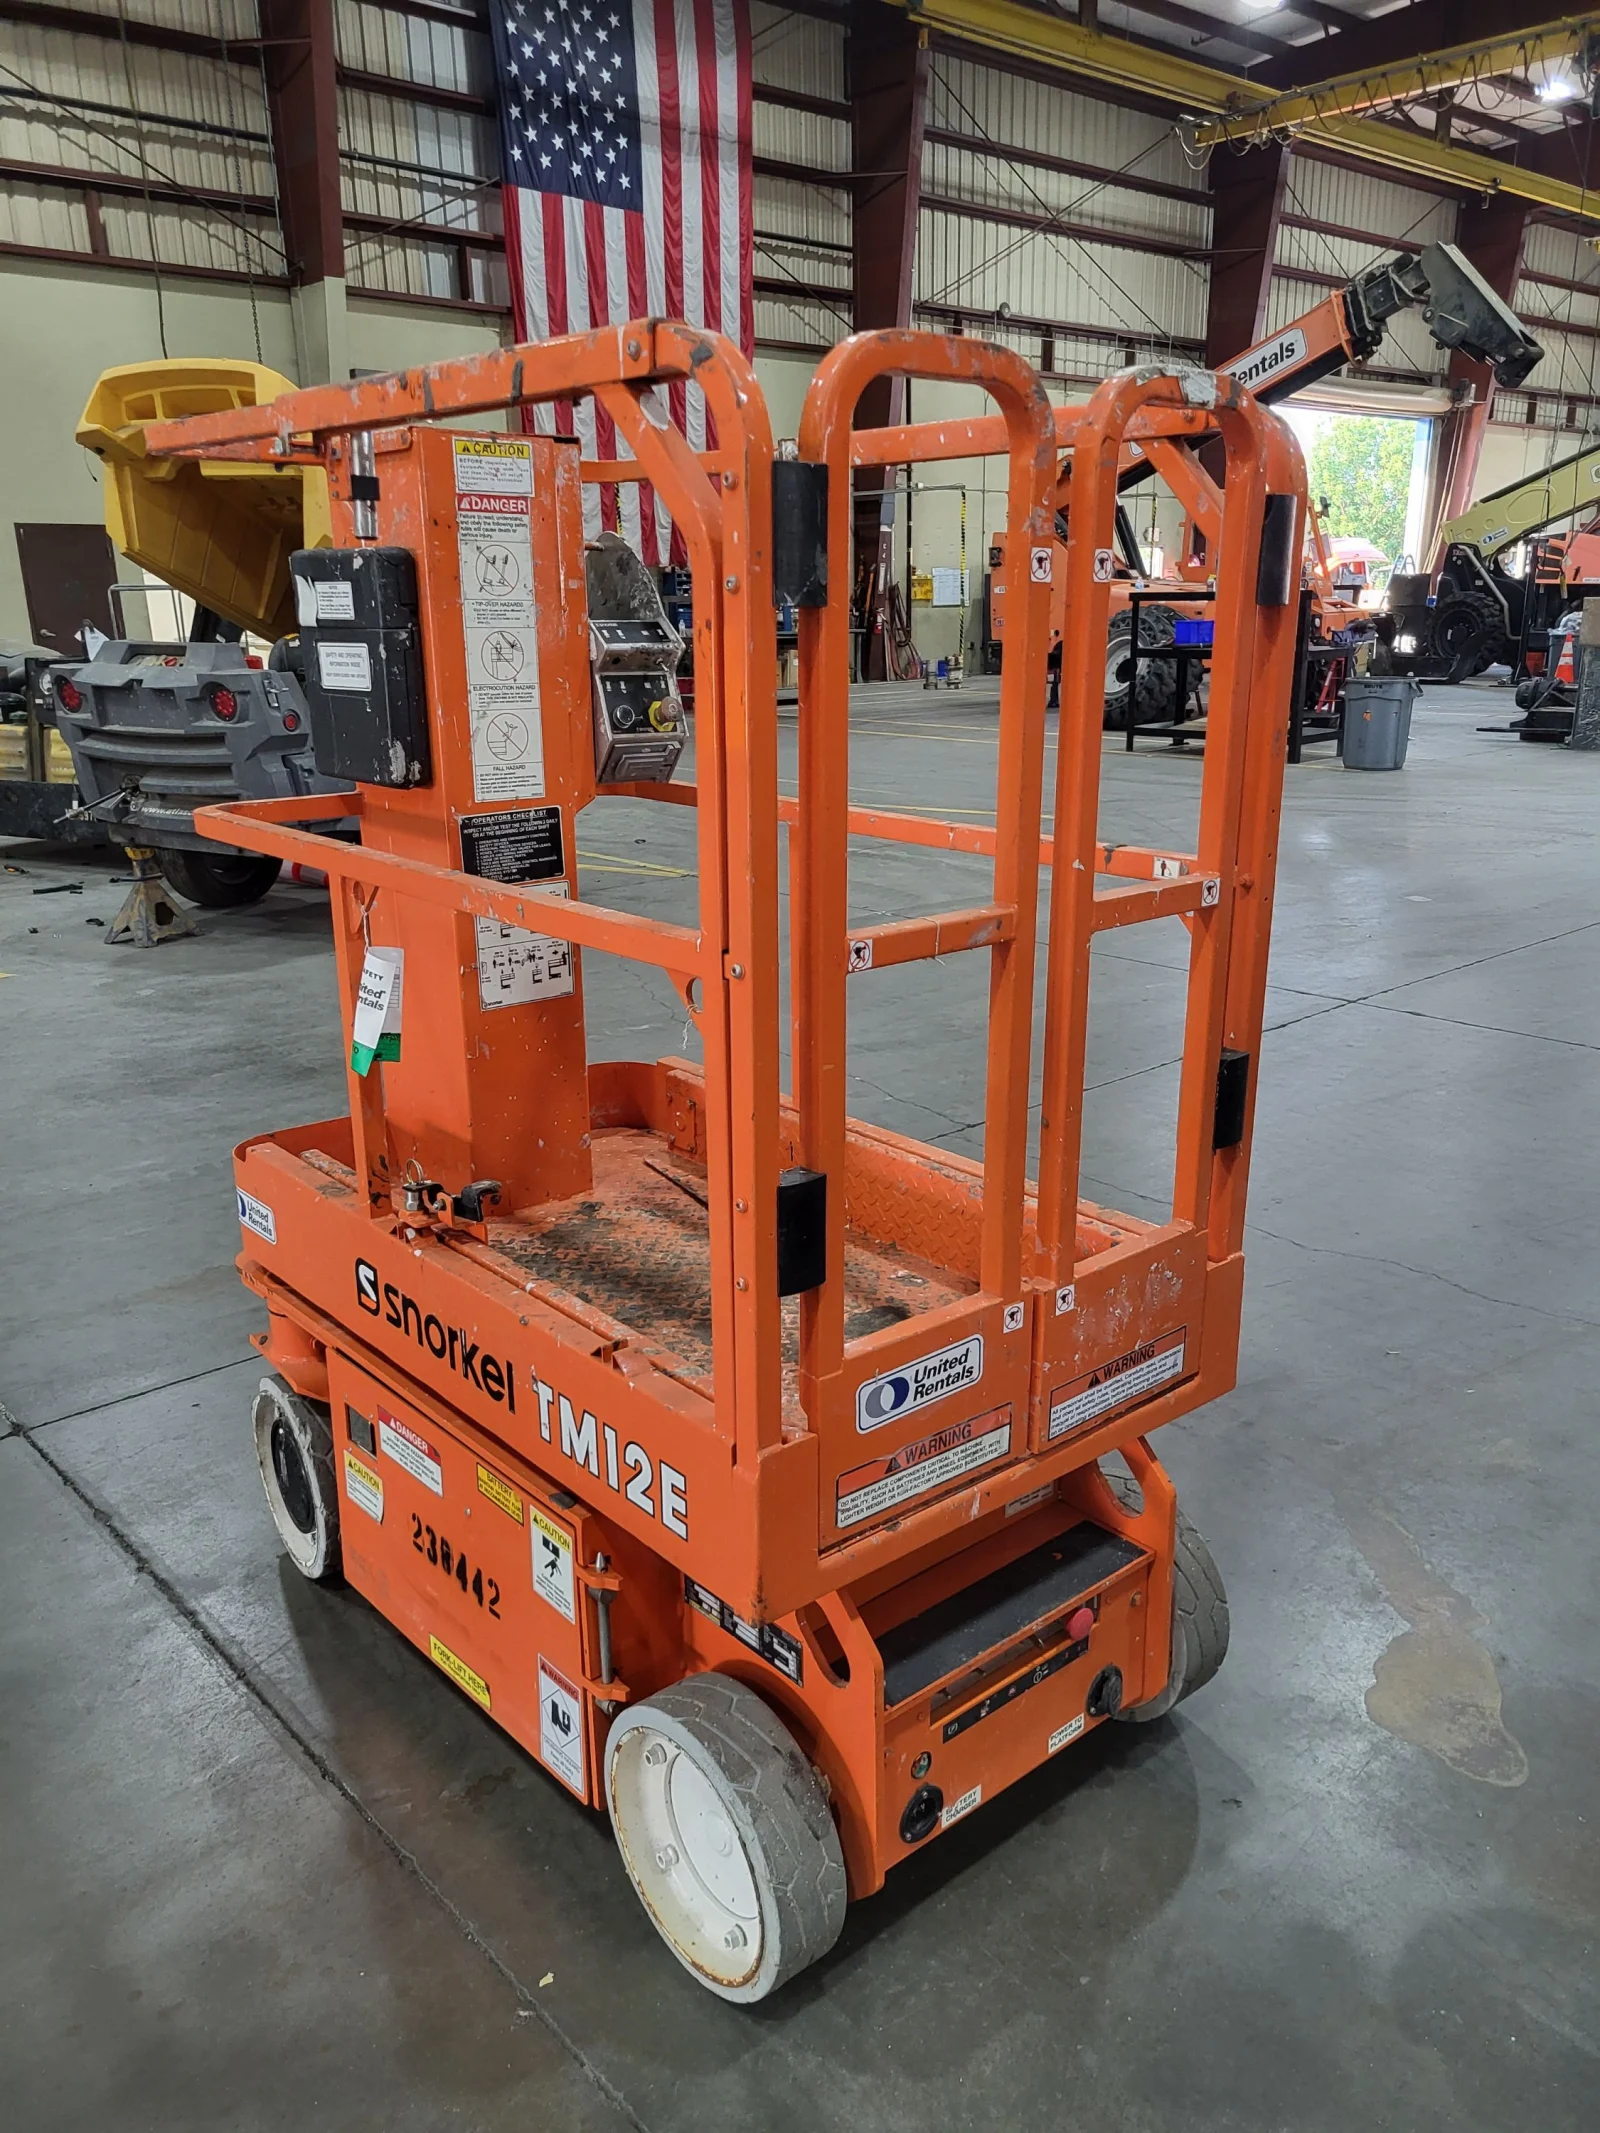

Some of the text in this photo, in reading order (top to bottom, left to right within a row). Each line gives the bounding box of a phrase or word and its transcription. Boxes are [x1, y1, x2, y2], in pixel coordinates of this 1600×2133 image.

[1229, 342, 1295, 385] entals
[474, 443, 524, 456] CAUTION
[472, 497, 526, 512] DANGER
[474, 814, 510, 823] OPERATORS
[247, 1200, 269, 1223] United
[248, 1212, 272, 1236] Rentals
[913, 1347, 970, 1384] United
[1103, 1344, 1154, 1380] WARNING
[913, 1364, 975, 1402] Rentals
[1060, 1395, 1083, 1412] personnel
[1084, 1389, 1095, 1400] shall
[1157, 1347, 1181, 1364] understand
[384, 1283, 515, 1414] snorkel
[533, 1378, 688, 1542] TM12E
[396, 1420, 428, 1454] DANGER
[904, 1423, 972, 1465] WARNING
[353, 1462, 380, 1490] CAUTION
[487, 1472, 511, 1498] BATTERY
[840, 1439, 982, 1508] DO NOT REPLACE COMPONENTS CRITICAL TO MACHINE
[871, 1489, 886, 1502] SUCH
[887, 1485, 895, 1494] AS
[896, 1472, 924, 1491] BATTERIES
[926, 1466, 937, 1477] AND
[938, 1458, 955, 1472] WHEEL
[988, 1438, 1000, 1450] WITH
[840, 1506, 864, 1523] LIGHTER
[865, 1496, 886, 1512] WEIGHT
[887, 1492, 895, 1502] OR
[935, 1462, 962, 1480] APPROVED
[539, 1518, 570, 1550] CAUTION
[433, 1641, 486, 1696] FORK-LIFT HERE
[548, 1670, 578, 1700] WARNING
[1050, 1716, 1082, 1741] POWER TO
[1050, 1724, 1082, 1750] PLATFORM
[946, 1798, 977, 1822] CHARGER
